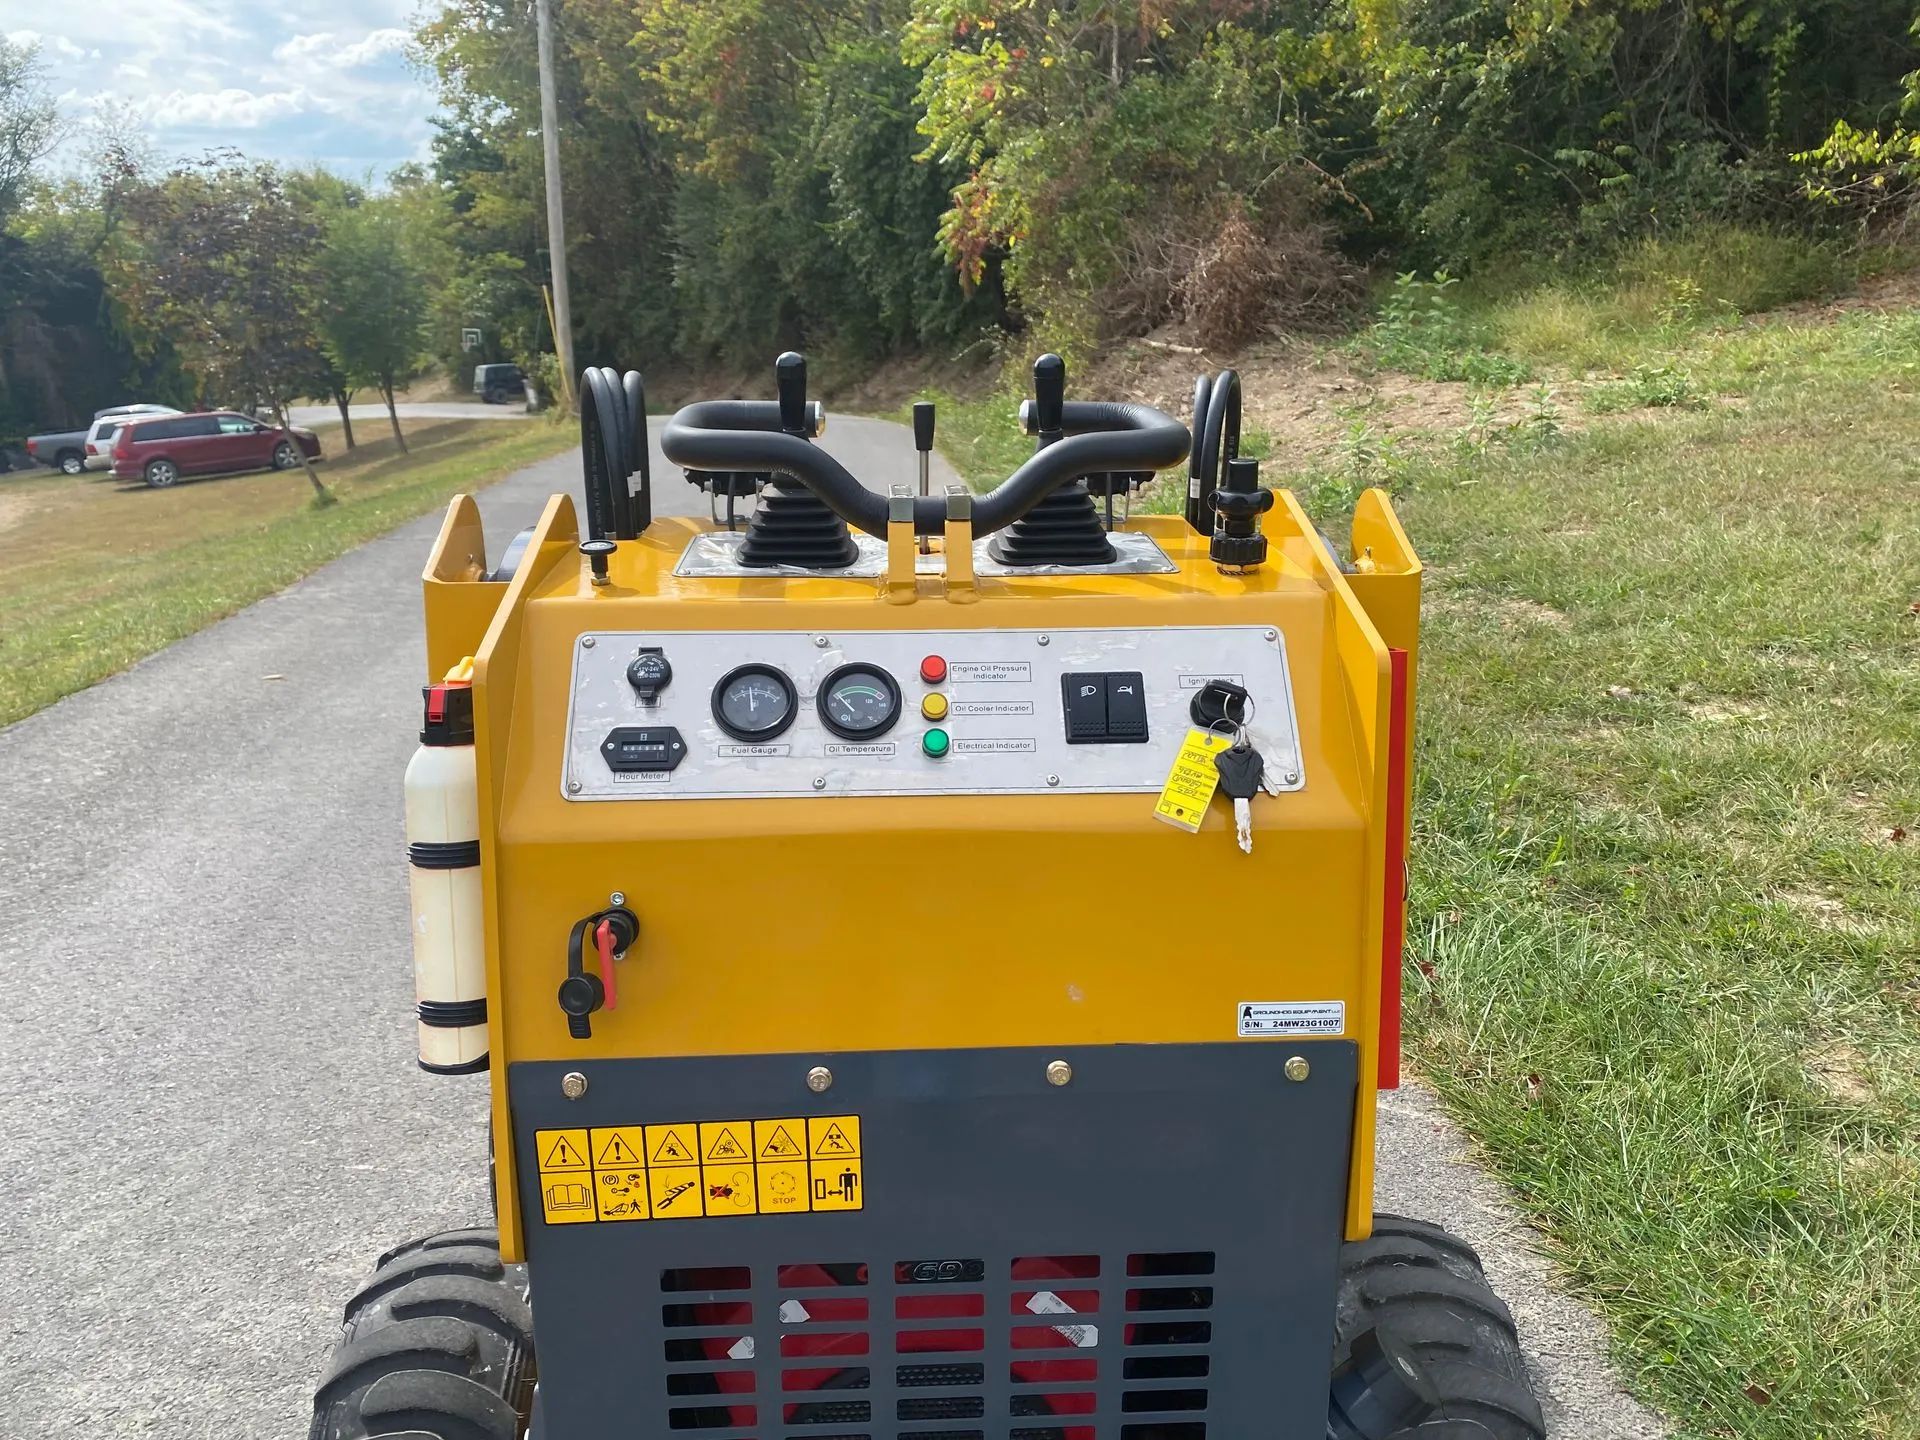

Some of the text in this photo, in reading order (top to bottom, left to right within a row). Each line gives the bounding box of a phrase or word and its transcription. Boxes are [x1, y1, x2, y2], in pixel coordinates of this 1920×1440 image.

[952, 665, 979, 673] Engine
[995, 704, 1029, 712] Indicator
[842, 745, 892, 754] Temperature
[957, 742, 995, 750] Electrical
[750, 747, 778, 755] Gauge
[619, 772, 665, 780] Hour Meter
[1272, 1019, 1339, 1028] 24MW23G1007
[772, 1197, 797, 1205] STOP
